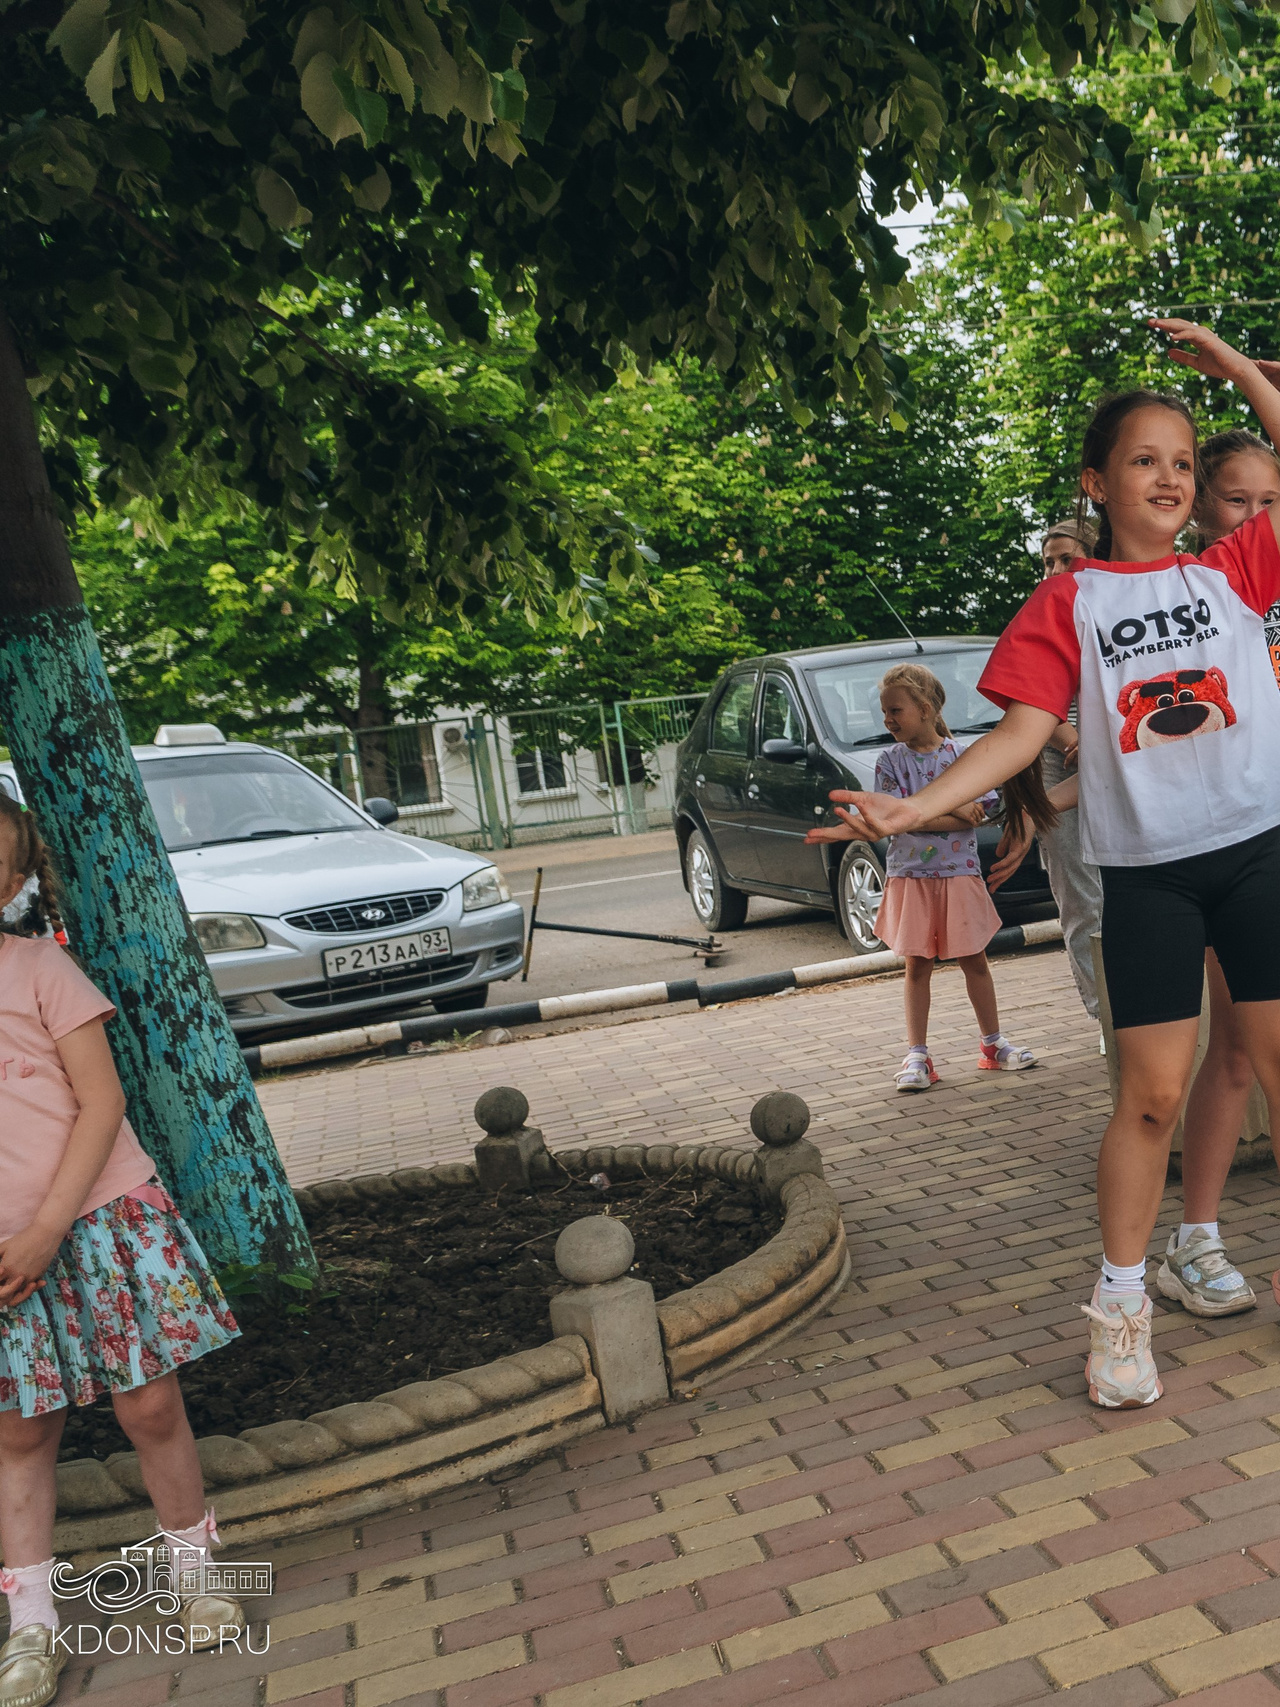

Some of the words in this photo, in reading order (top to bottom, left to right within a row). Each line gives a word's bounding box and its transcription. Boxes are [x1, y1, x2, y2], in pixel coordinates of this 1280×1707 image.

[1097, 598, 1211, 658] LOTSO
[1103, 637, 1193, 668] STRAWBERRY
[1196, 626, 1220, 643] BER
[422, 932, 442, 949] 93
